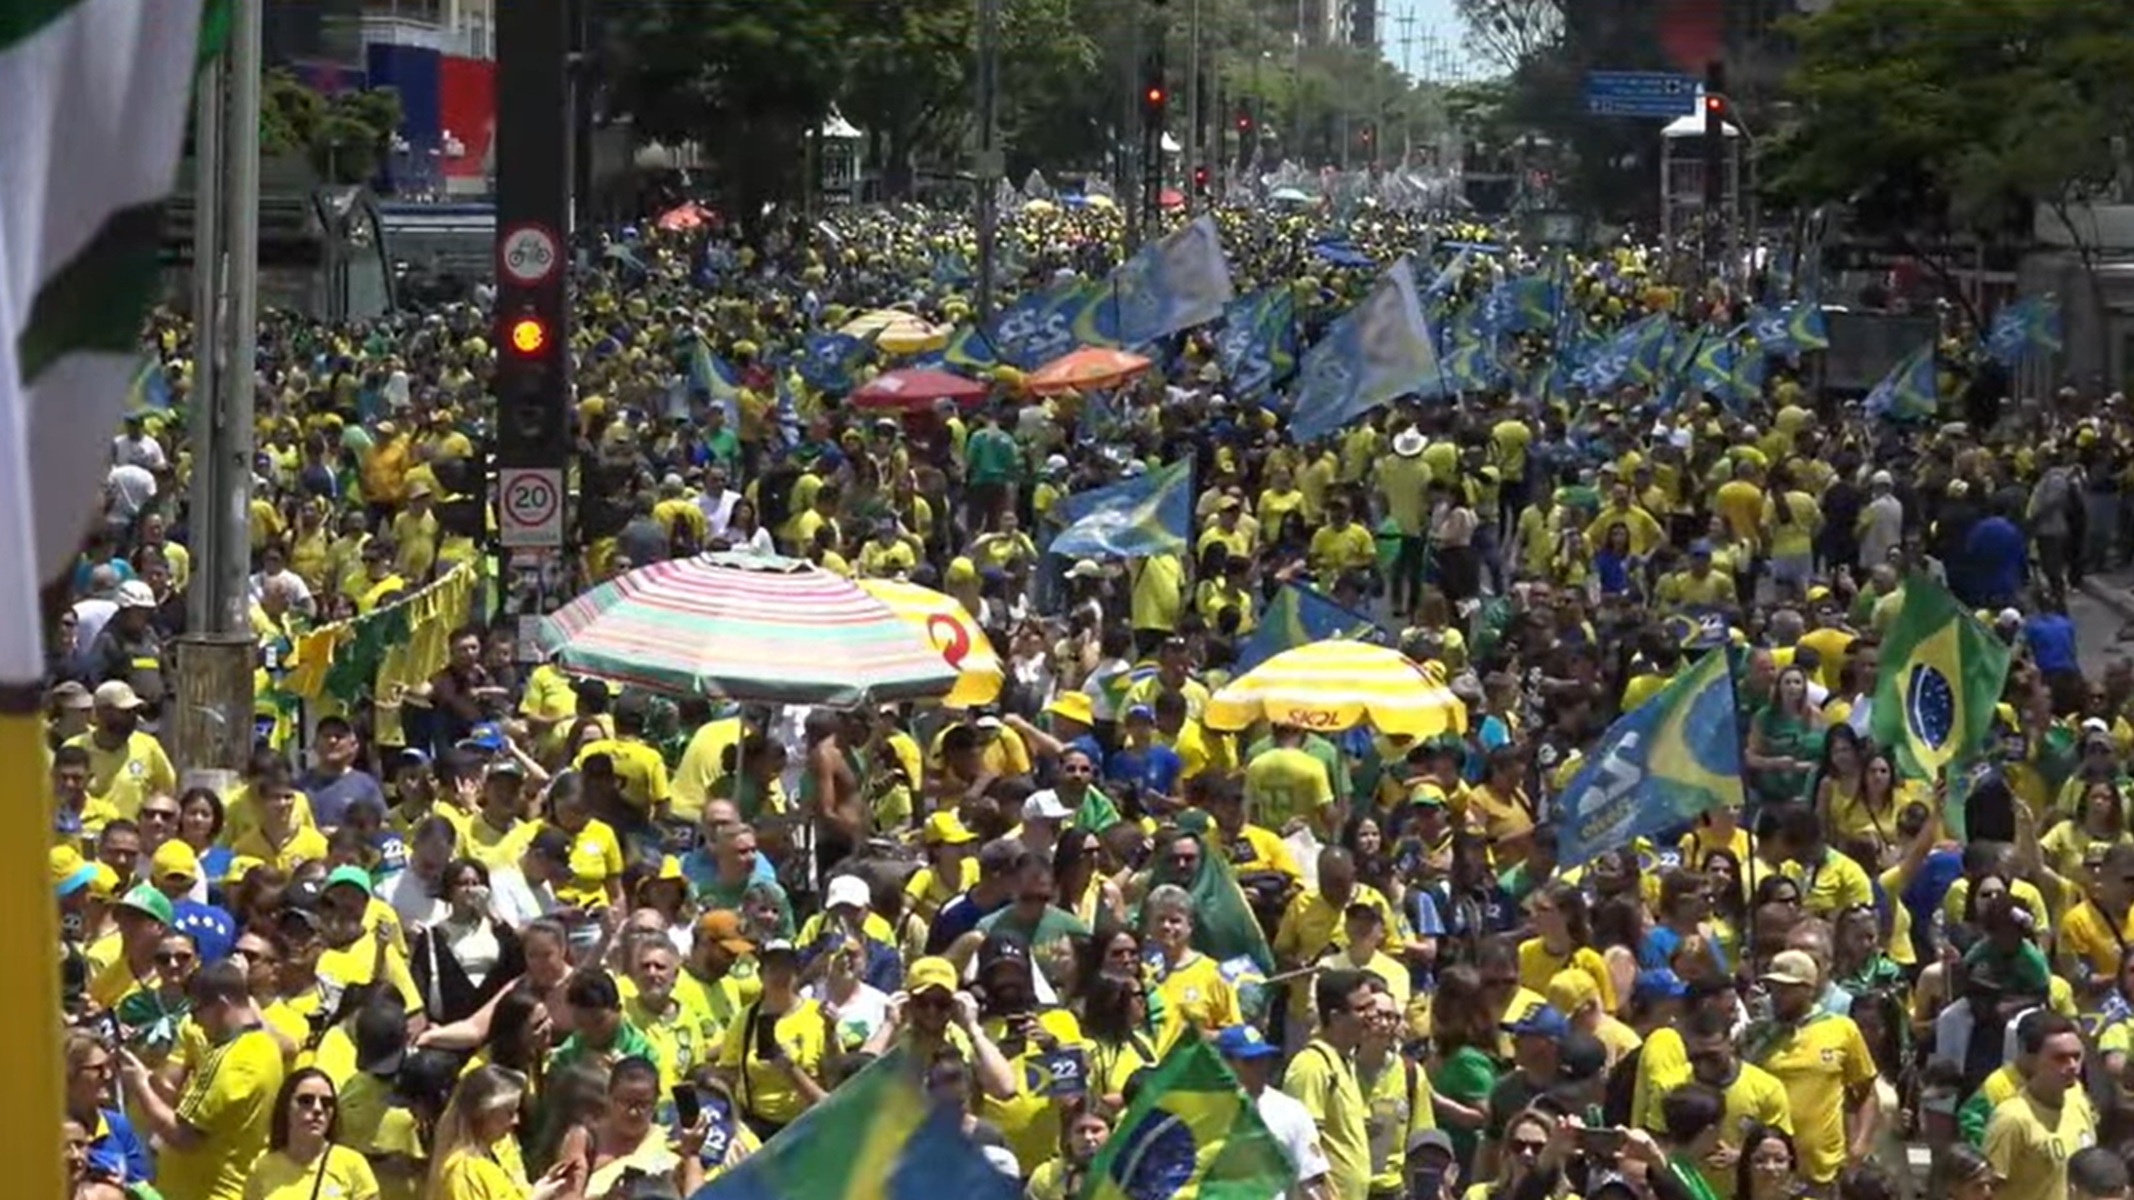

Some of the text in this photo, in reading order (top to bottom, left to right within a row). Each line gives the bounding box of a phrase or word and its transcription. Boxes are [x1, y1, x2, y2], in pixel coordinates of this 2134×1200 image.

[515, 486, 547, 508] 20
[1700, 613, 1723, 629] 22
[1287, 709, 1341, 727] SKOL
[382, 838, 403, 858] 22
[1661, 852, 1680, 867] 22
[1052, 1060, 1079, 1080] 22
